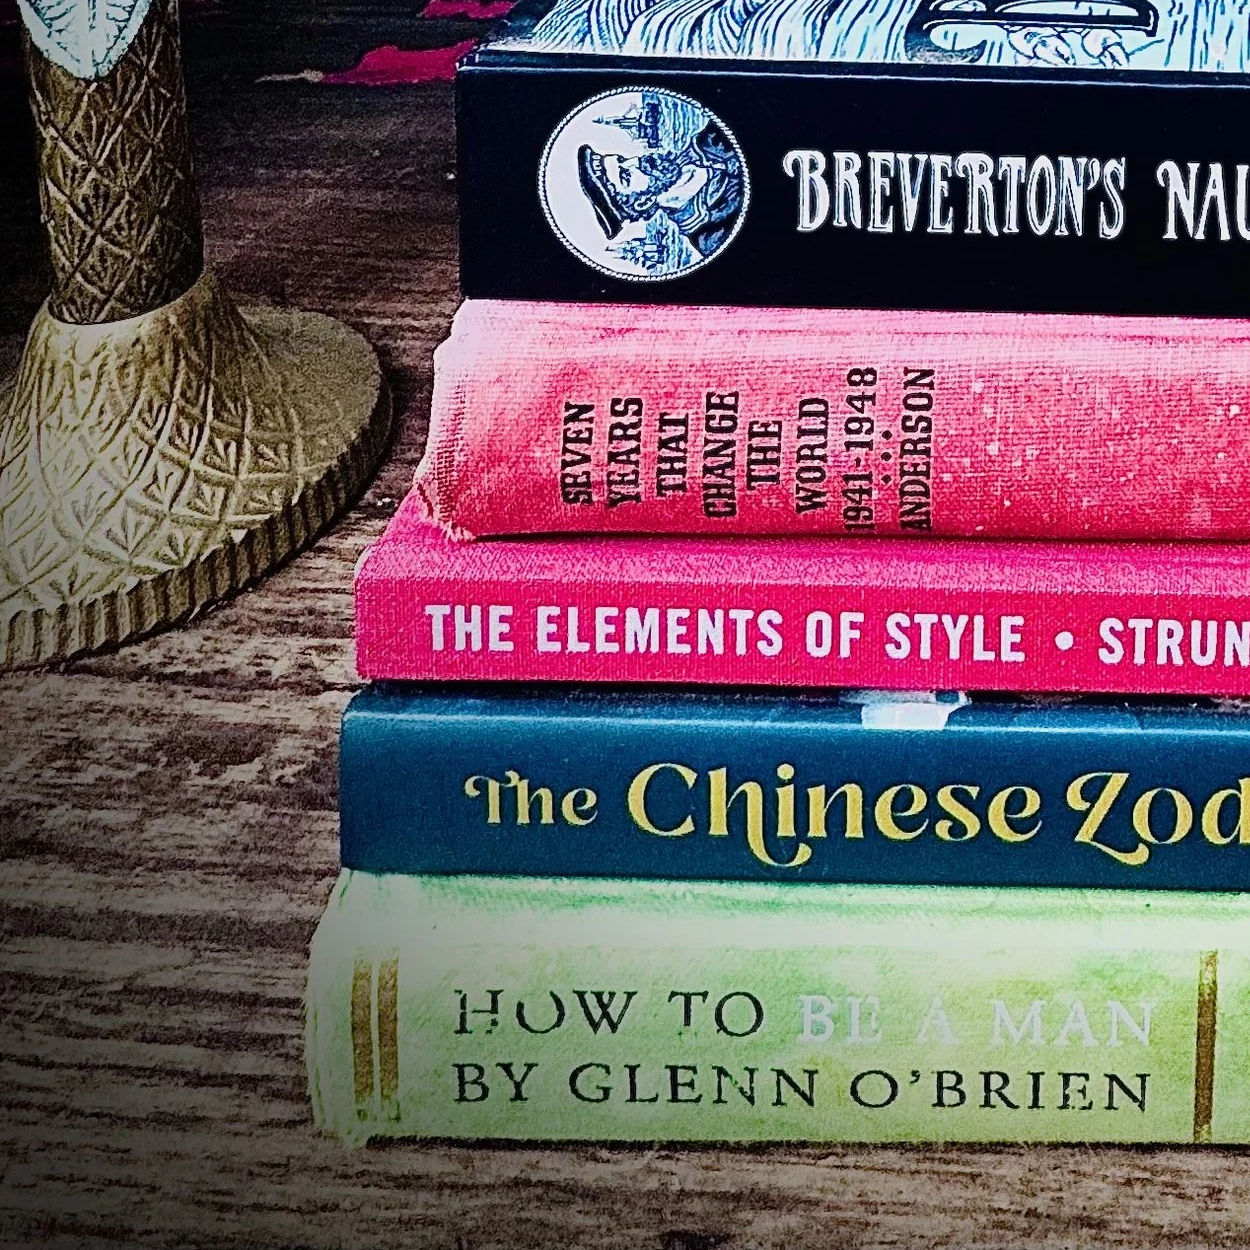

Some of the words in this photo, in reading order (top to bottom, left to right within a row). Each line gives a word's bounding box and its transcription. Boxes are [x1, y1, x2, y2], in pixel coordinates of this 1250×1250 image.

[782, 149, 1126, 239] BREVERTON'S
[560, 402, 595, 505] SEVEN
[606, 397, 643, 508] YEARS
[656, 411, 689, 498] THAT
[703, 391, 739, 518] CHANGE
[746, 420, 782, 491] THE
[795, 398, 829, 514] WORLD
[842, 366, 878, 532] 1941-1948
[899, 366, 935, 532] ANDERSON
[424, 604, 514, 651] THE
[535, 605, 783, 656] ELEMENTS
[805, 611, 864, 658] OF
[884, 613, 1025, 662] STYLE
[464, 770, 599, 826] The
[627, 762, 1042, 868] Chinese
[453, 989, 639, 1037] HOW
[668, 990, 765, 1038] TO
[800, 994, 881, 1045] BE
[915, 998, 956, 1046] A
[990, 999, 1155, 1048] MAN
[452, 1062, 539, 1103] BY
[568, 1062, 818, 1109] GLENN
[850, 1068, 1152, 1112] O'BRIEN
